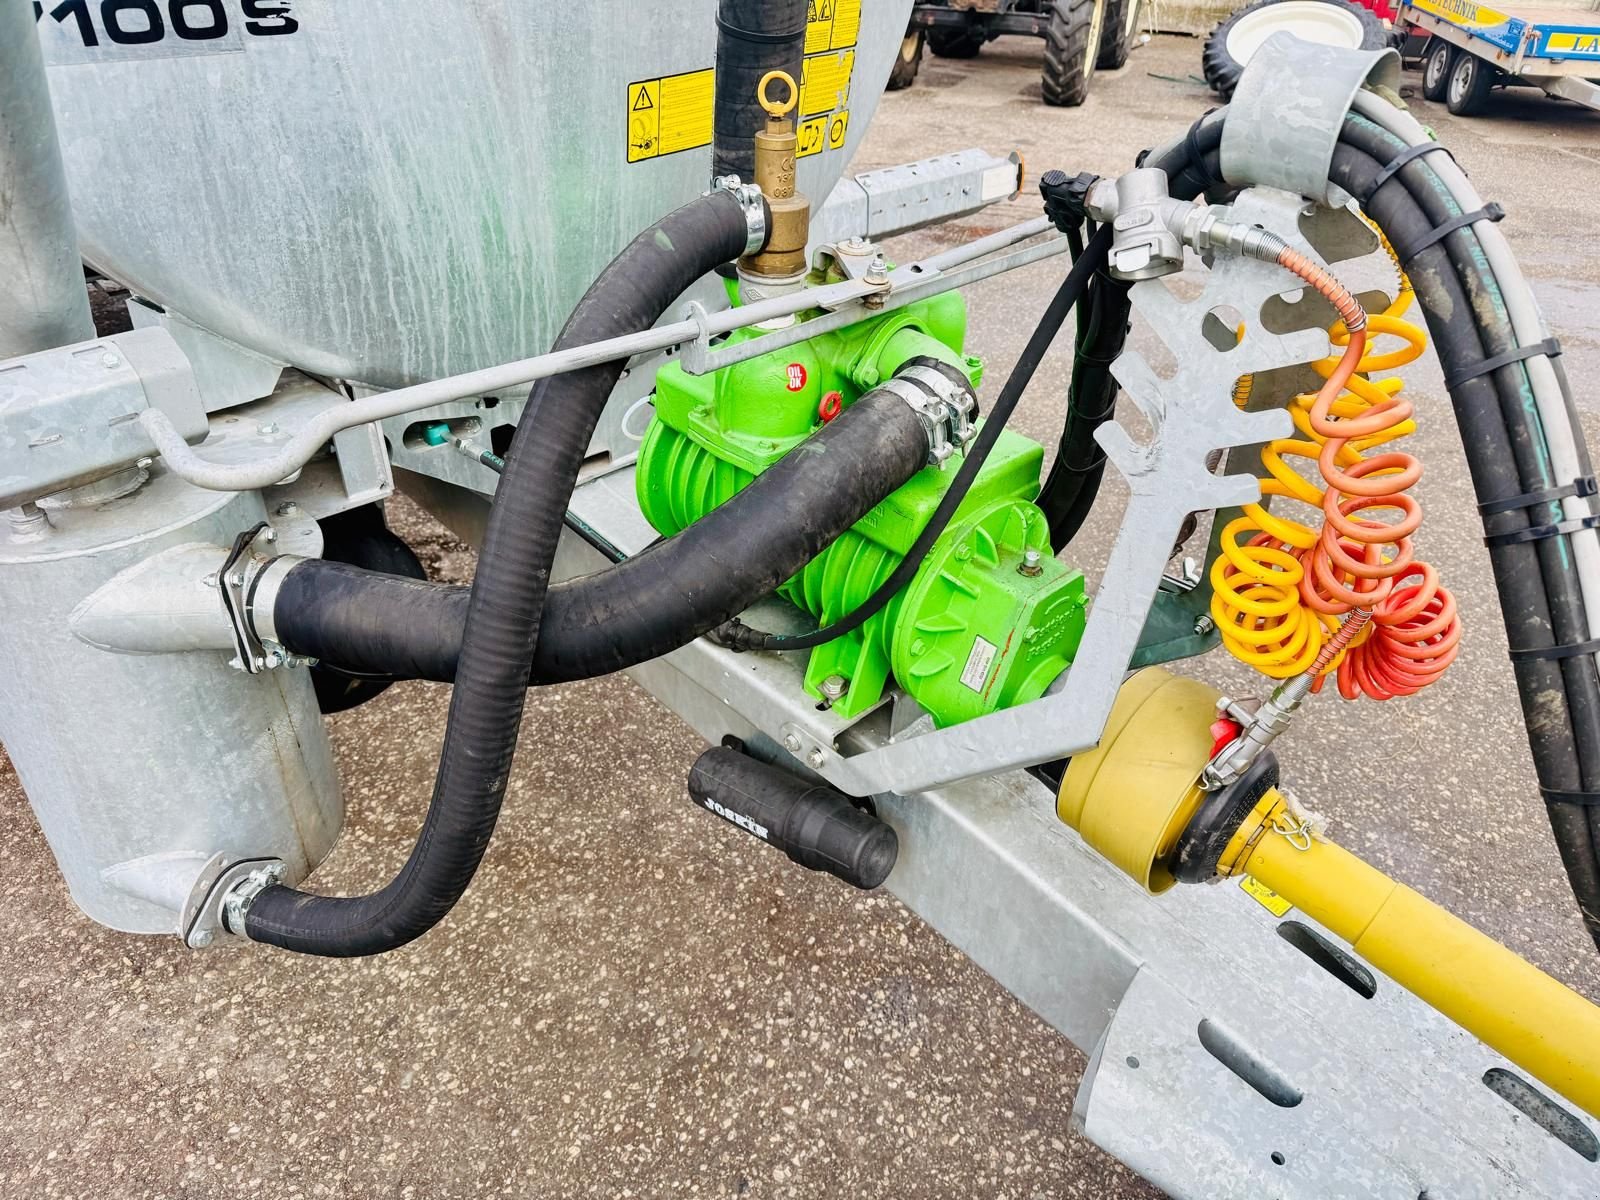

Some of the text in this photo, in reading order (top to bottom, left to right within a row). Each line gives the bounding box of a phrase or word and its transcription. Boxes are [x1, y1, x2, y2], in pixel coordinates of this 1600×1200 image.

[1570, 36, 1599, 52] LA
[787, 365, 803, 378] OIL
[789, 377, 802, 389] OK
